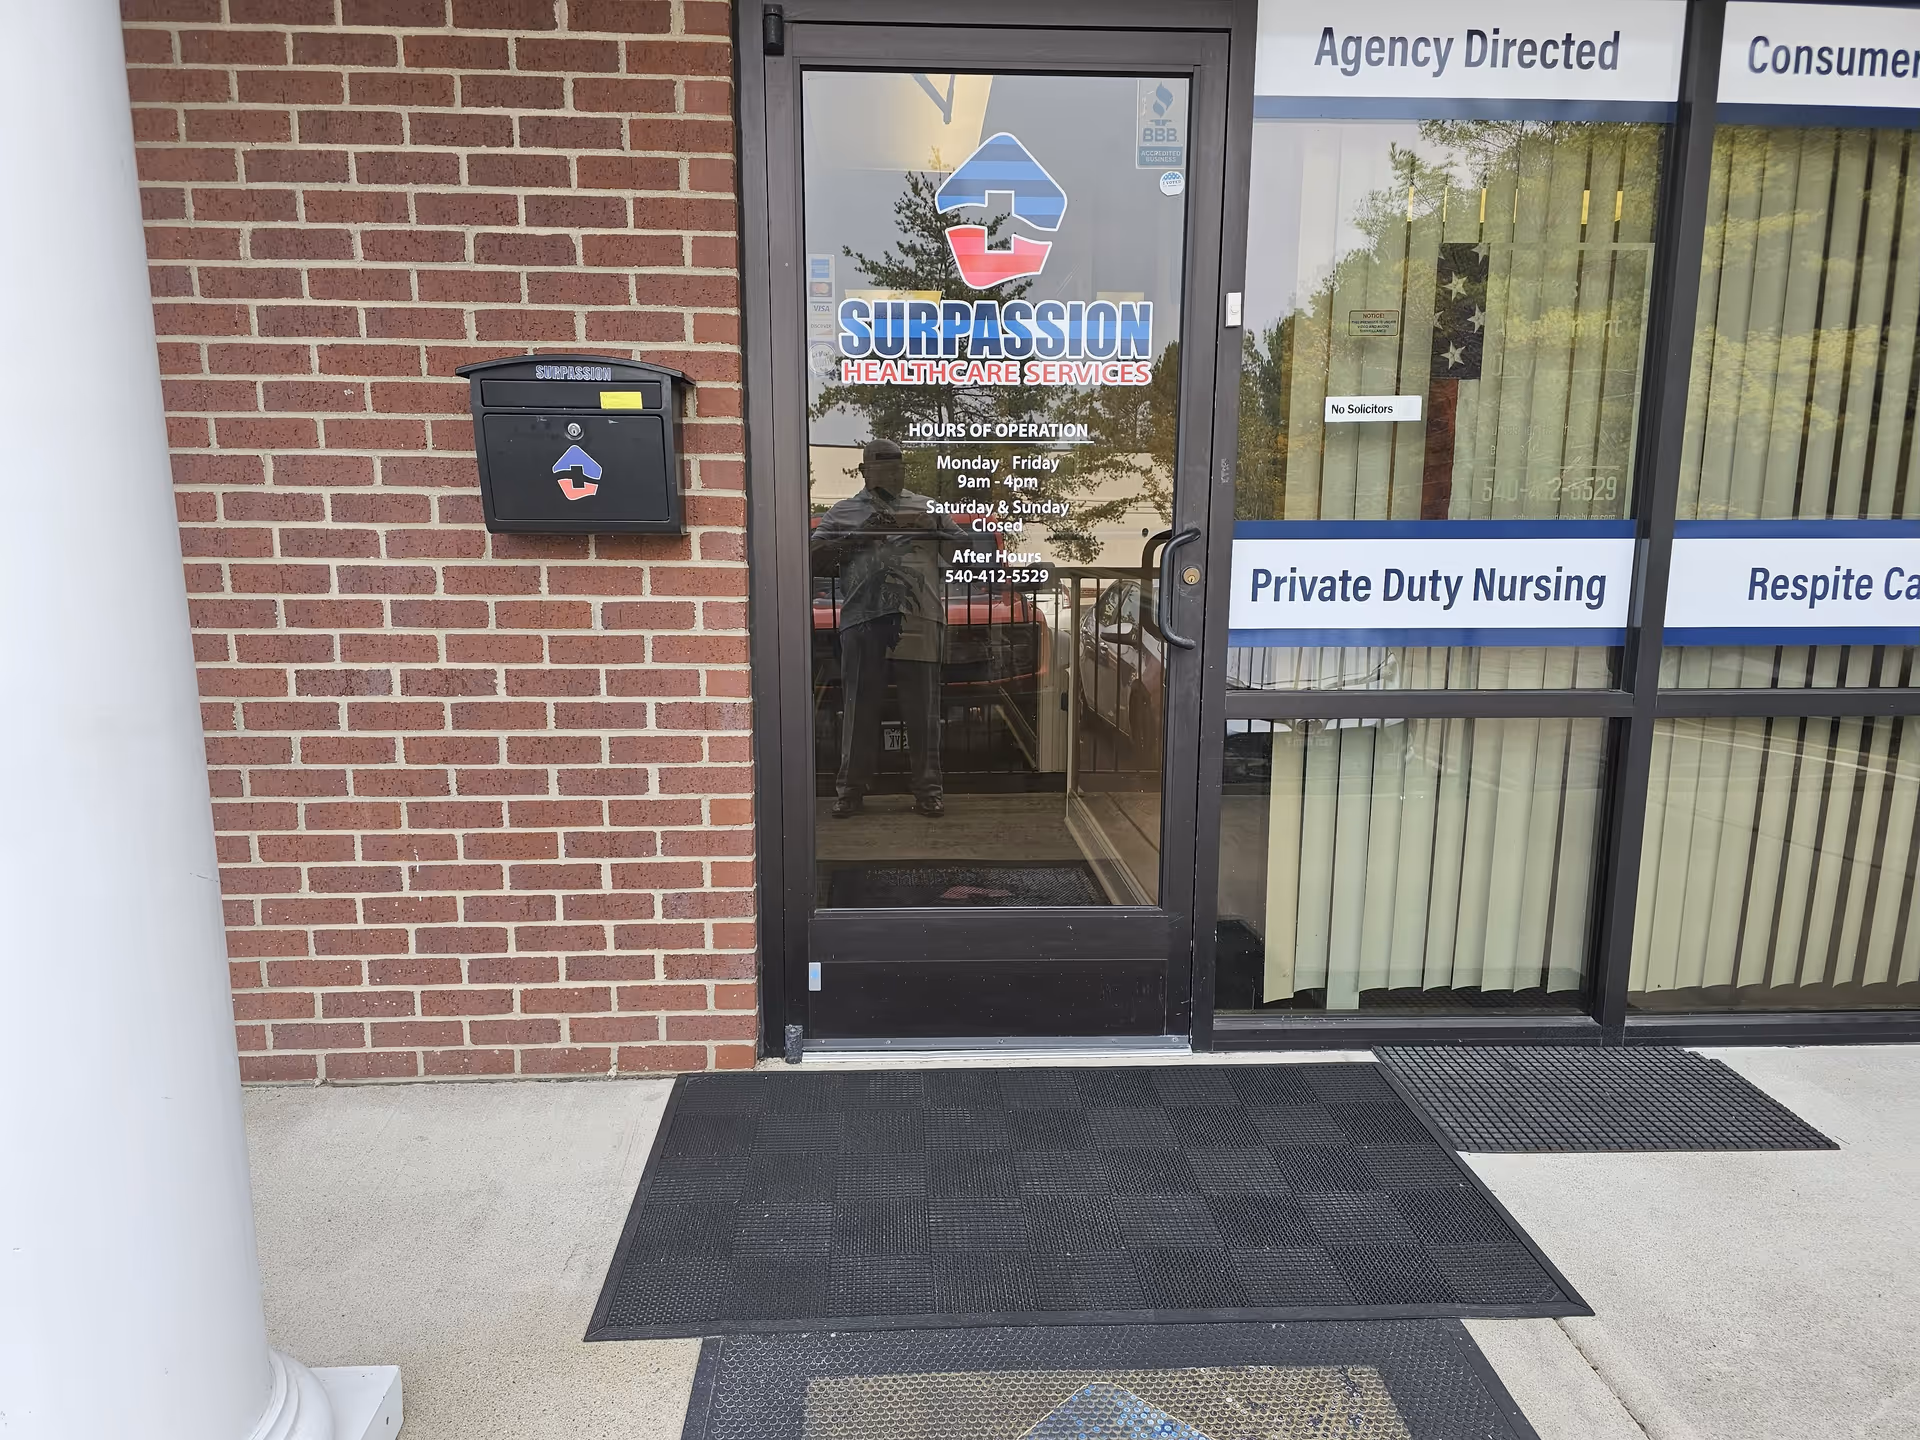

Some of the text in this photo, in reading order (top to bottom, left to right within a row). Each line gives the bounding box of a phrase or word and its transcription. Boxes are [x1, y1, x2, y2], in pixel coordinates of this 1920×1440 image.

[1313, 26, 1621, 78] Agency Directed
[838, 298, 1154, 359] SURPASSION
[535, 364, 612, 381] SURPASSION
[842, 360, 1019, 385] HEALTHCARE
[1024, 361, 1152, 385] SERVICES
[1331, 403, 1394, 414] No Solicitors
[908, 423, 1088, 438] HOURS OF OPERATION
[936, 455, 1060, 473] Monday Friday
[957, 474, 991, 489] 9am
[1003, 474, 1038, 491] 4pm
[926, 500, 1070, 517] Saturday & Sunday
[971, 518, 1023, 532] Closed
[952, 550, 1042, 563] After Hours
[945, 569, 1049, 583] 540-412-5529
[1250, 566, 1607, 611] Private Duty Nursing
[1748, 565, 1920, 609] Respite Ca
